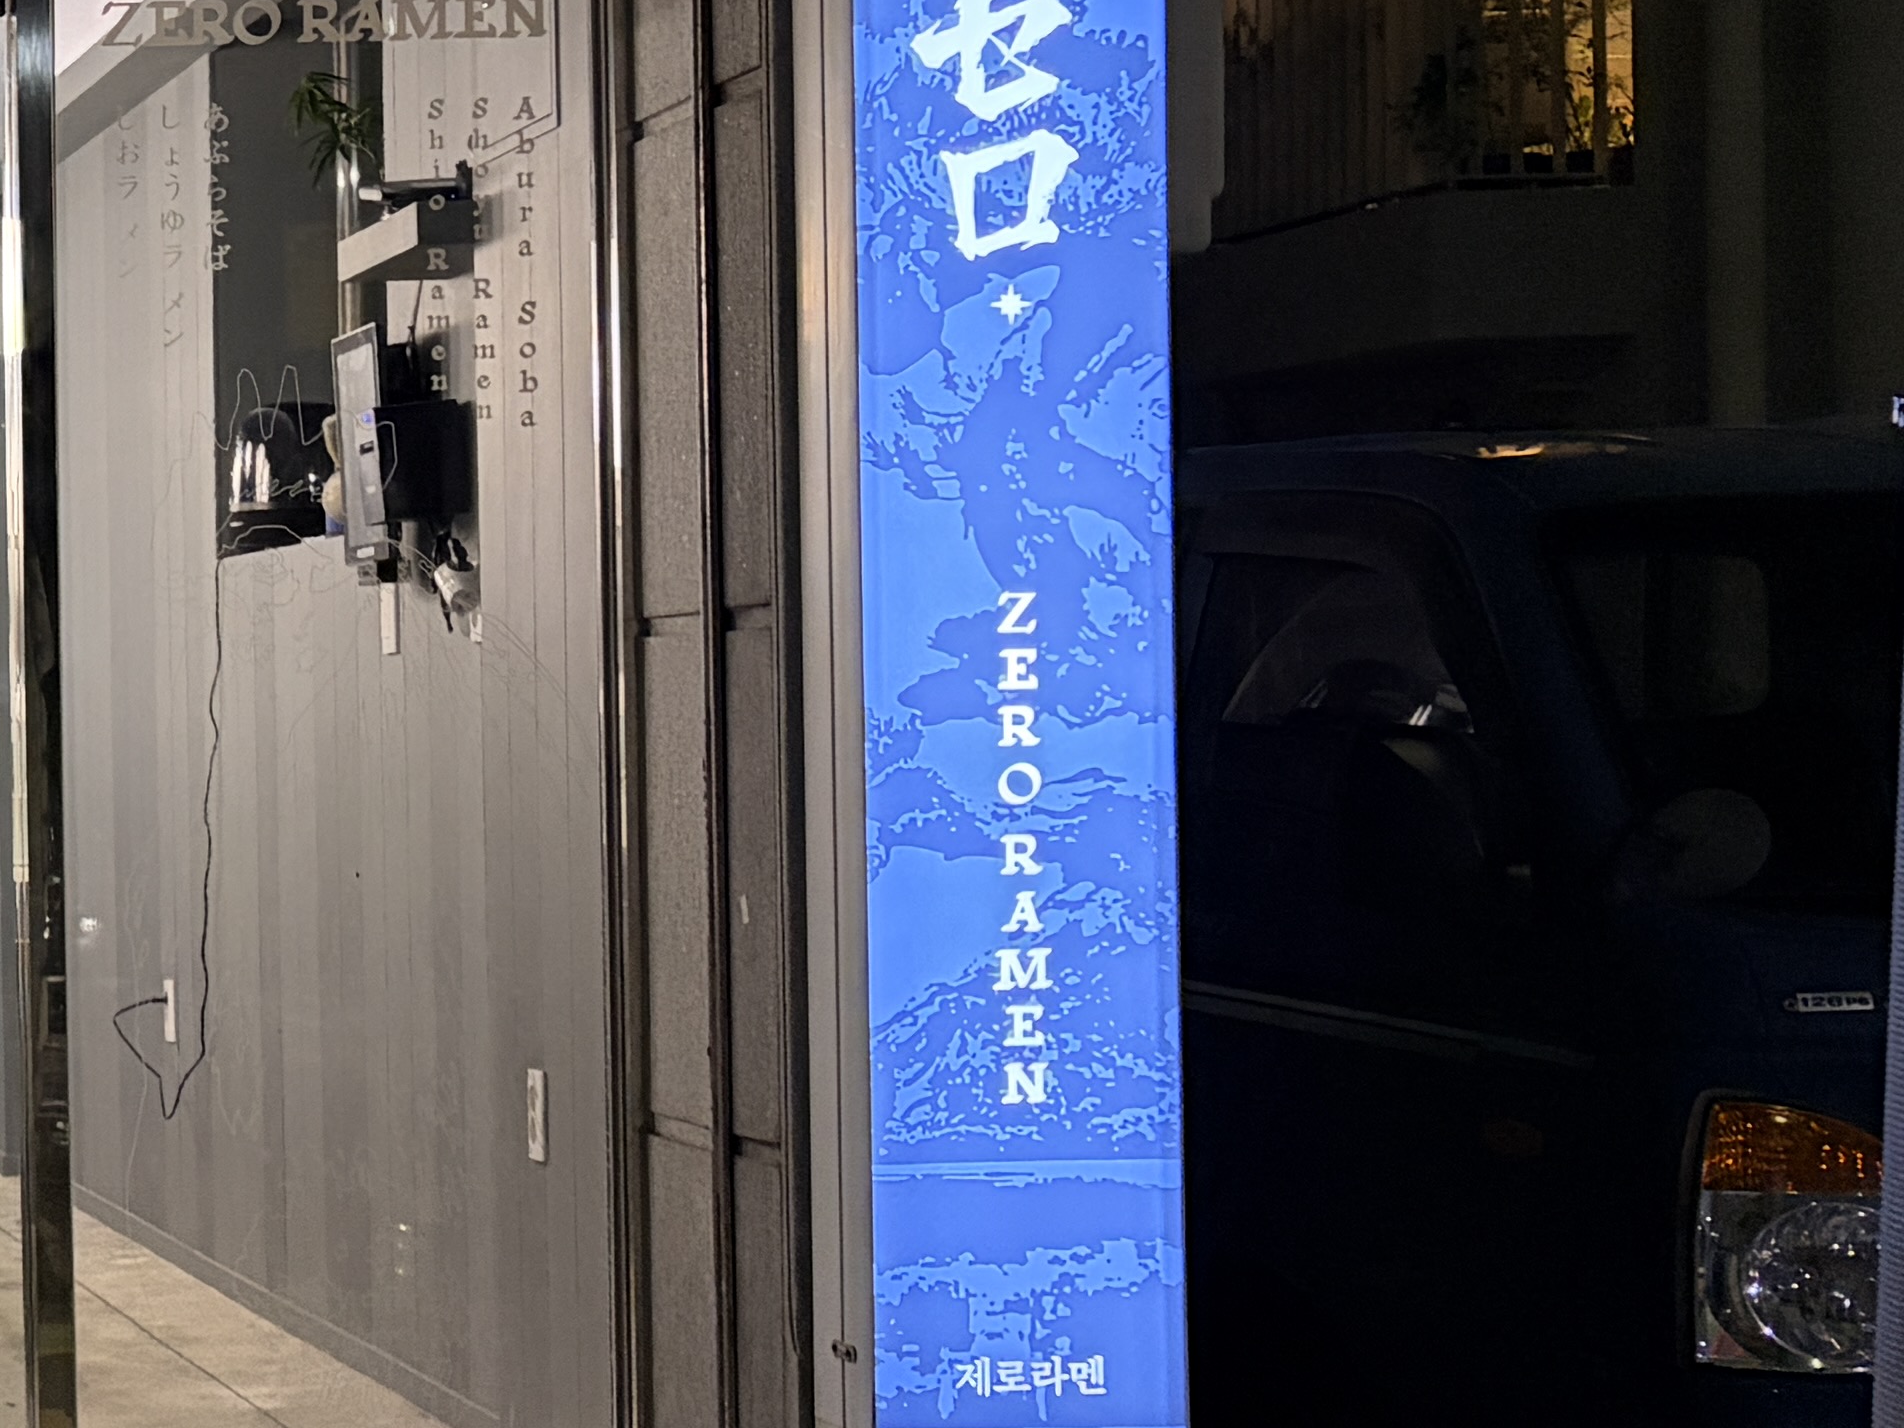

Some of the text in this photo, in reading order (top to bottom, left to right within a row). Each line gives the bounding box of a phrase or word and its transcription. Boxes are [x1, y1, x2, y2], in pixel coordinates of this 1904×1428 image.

[426, 97, 451, 393] Shio Ramen
[472, 278, 496, 420] Ramen
[512, 95, 539, 428] Abura Soba
[992, 590, 1055, 1106] ZERO RAMEN
[954, 1354, 1108, 1398] 제로라멘
